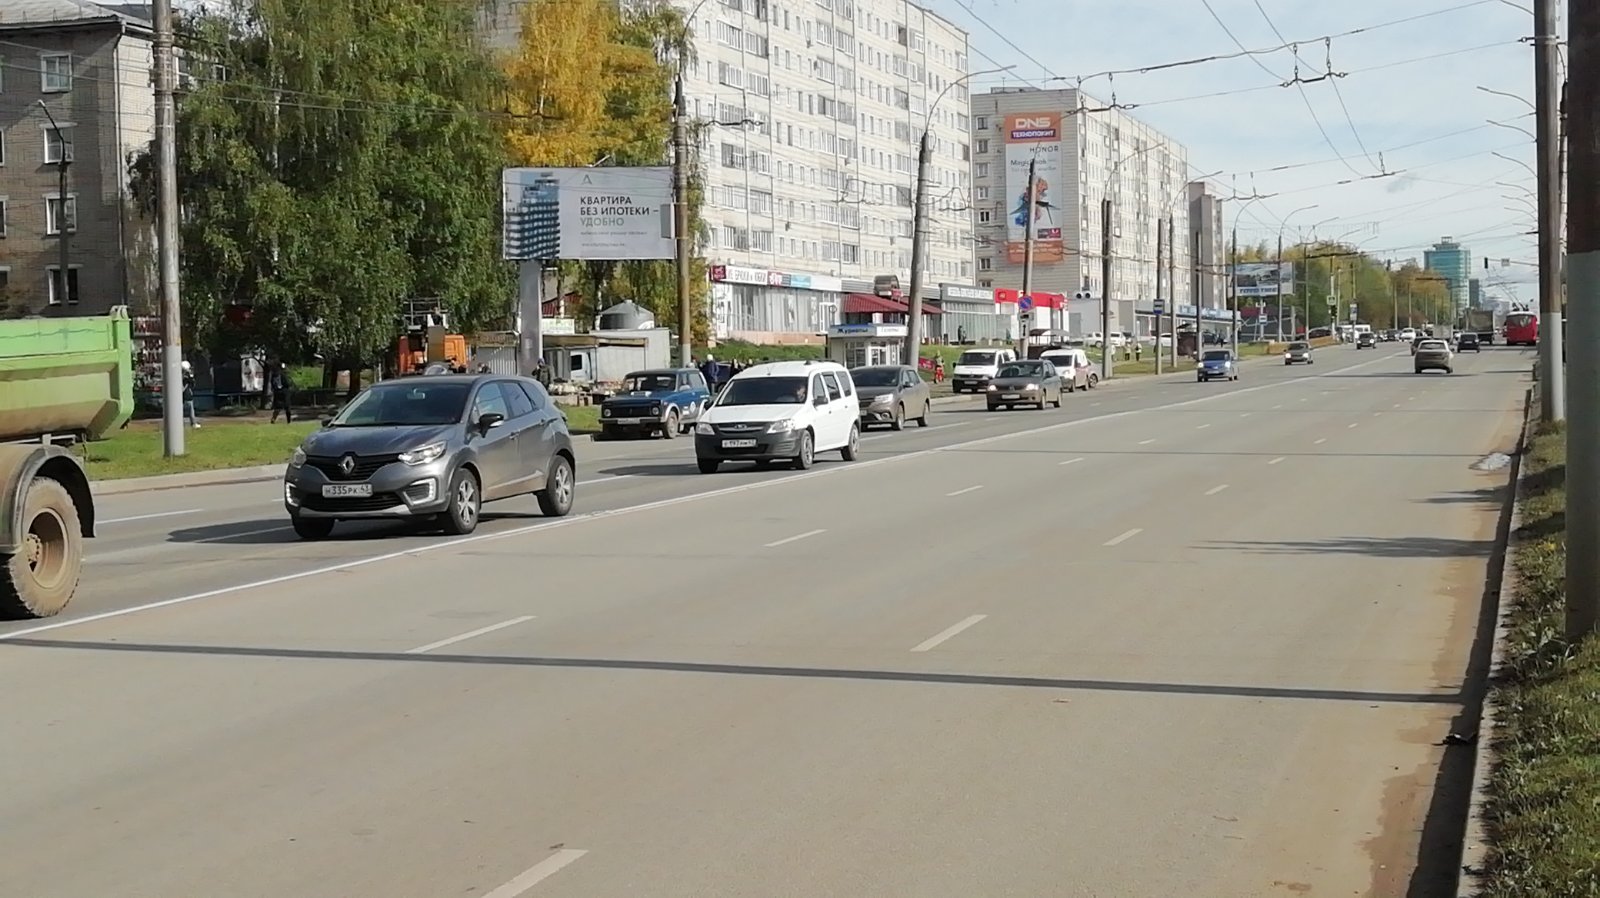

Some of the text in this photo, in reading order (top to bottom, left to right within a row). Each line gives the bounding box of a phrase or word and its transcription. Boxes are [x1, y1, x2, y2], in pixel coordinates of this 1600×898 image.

[1015, 117, 1051, 129] DNS
[580, 196, 632, 204] КВАРТИРА
[580, 207, 598, 216] БЕЗ
[601, 207, 650, 216] ИПОТЕКИ
[580, 217, 625, 227] УДОБНО
[325, 485, 358, 495] Н335РК
